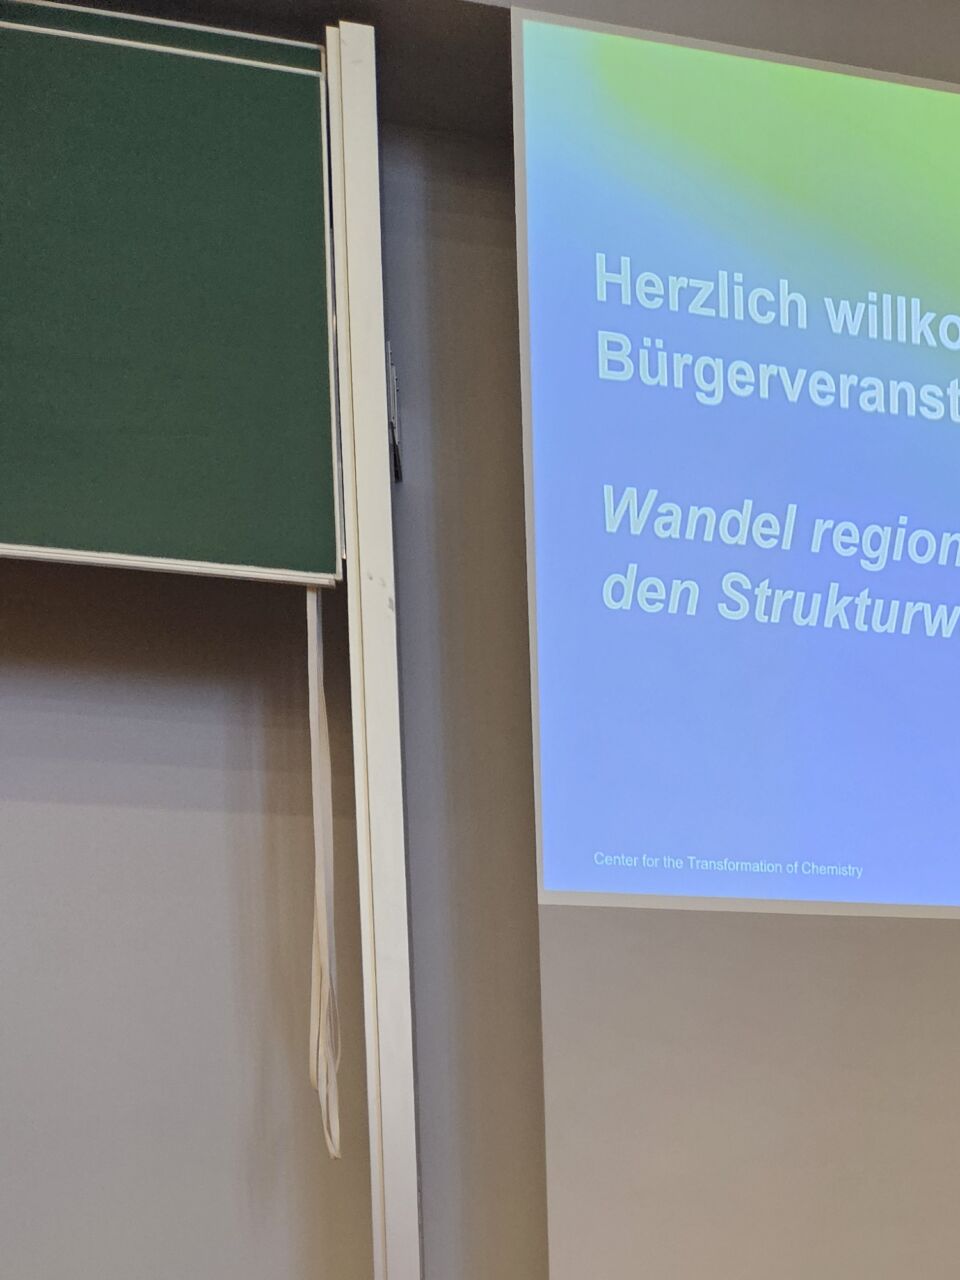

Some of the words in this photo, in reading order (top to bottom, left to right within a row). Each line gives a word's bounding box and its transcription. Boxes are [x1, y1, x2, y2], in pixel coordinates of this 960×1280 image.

[595, 252, 808, 329] Herzlich
[603, 484, 797, 550] Wandel
[602, 563, 699, 616] den
[593, 851, 638, 867] Center
[642, 853, 658, 868] for
[663, 855, 683, 869] the
[687, 855, 782, 874] Transformation
[786, 860, 800, 874] of
[801, 861, 863, 879] Chemistry
